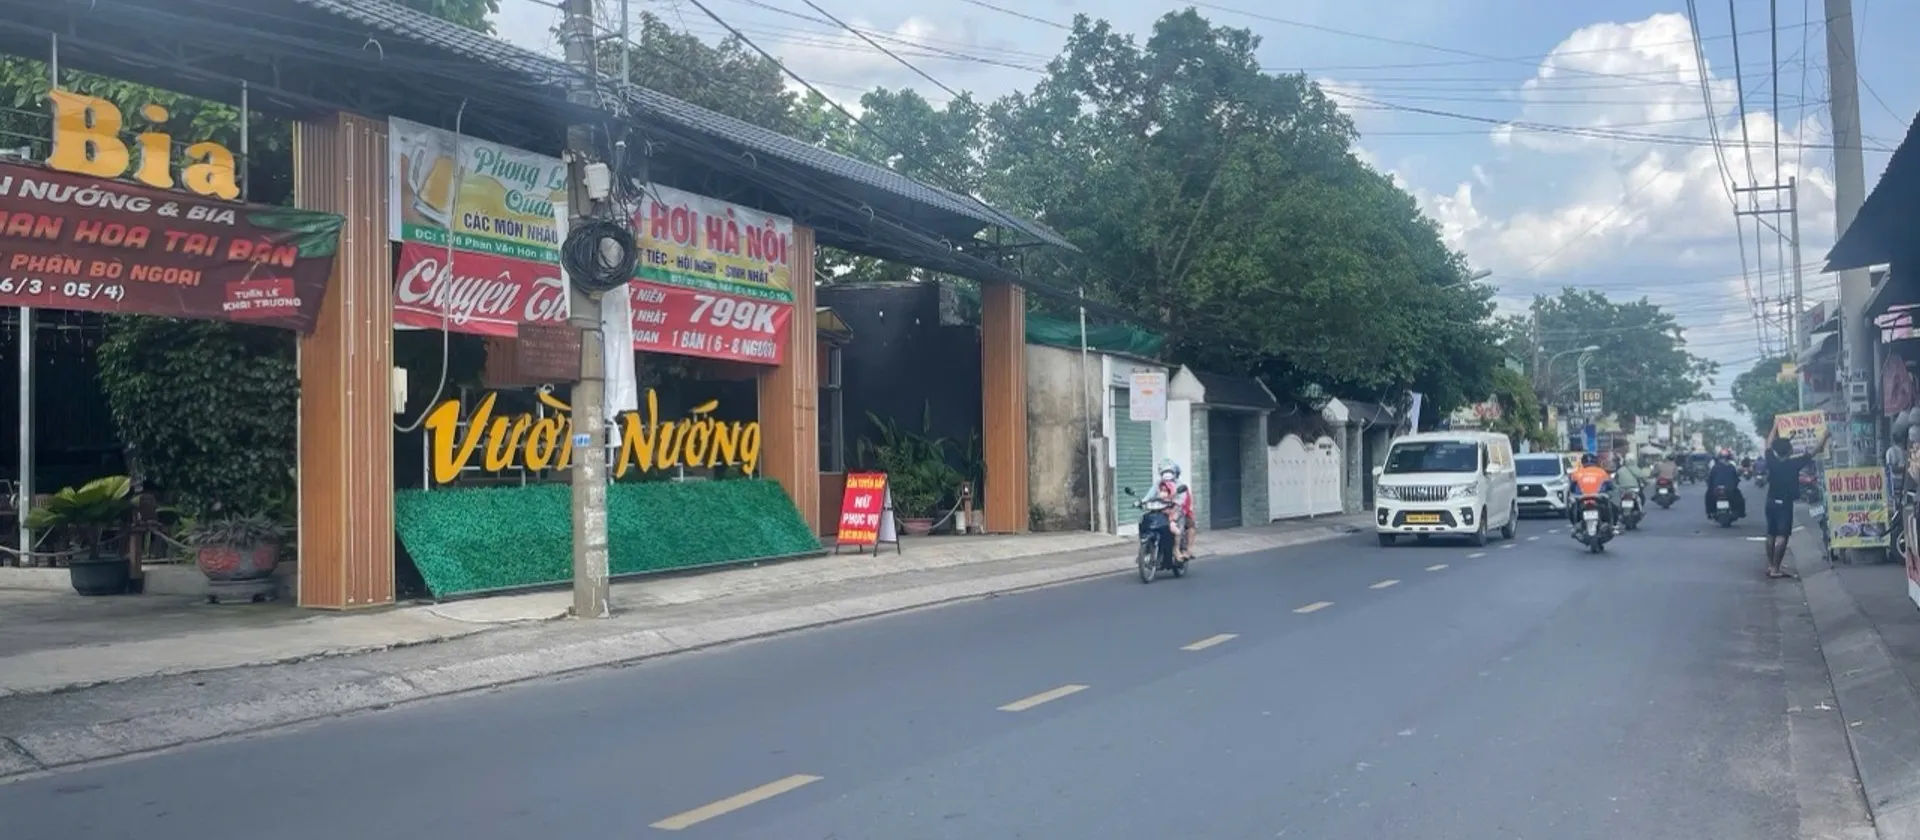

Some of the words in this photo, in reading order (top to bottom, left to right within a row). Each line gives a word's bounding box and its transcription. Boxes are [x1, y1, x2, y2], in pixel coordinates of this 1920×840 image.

[46, 88, 240, 200] Bia
[474, 147, 541, 192] Phong
[19, 179, 151, 212] NƯỚNG
[157, 202, 180, 217] &
[186, 205, 236, 225] BIA
[463, 211, 491, 232] CÁC
[651, 201, 698, 247] HƠI
[706, 207, 740, 256] HÀ
[745, 216, 788, 273] NỘI
[227, 234, 298, 268] BÀN
[465, 236, 492, 250] Phan
[89, 256, 123, 279] BÒ
[63, 281, 125, 302] 05/4)
[399, 258, 521, 325] Chuyên
[689, 294, 780, 335] 799K
[672, 330, 679, 348] 1
[681, 328, 706, 350] BÀN
[616, 388, 761, 478] Nướng
[1848, 511, 1870, 523] 25K
